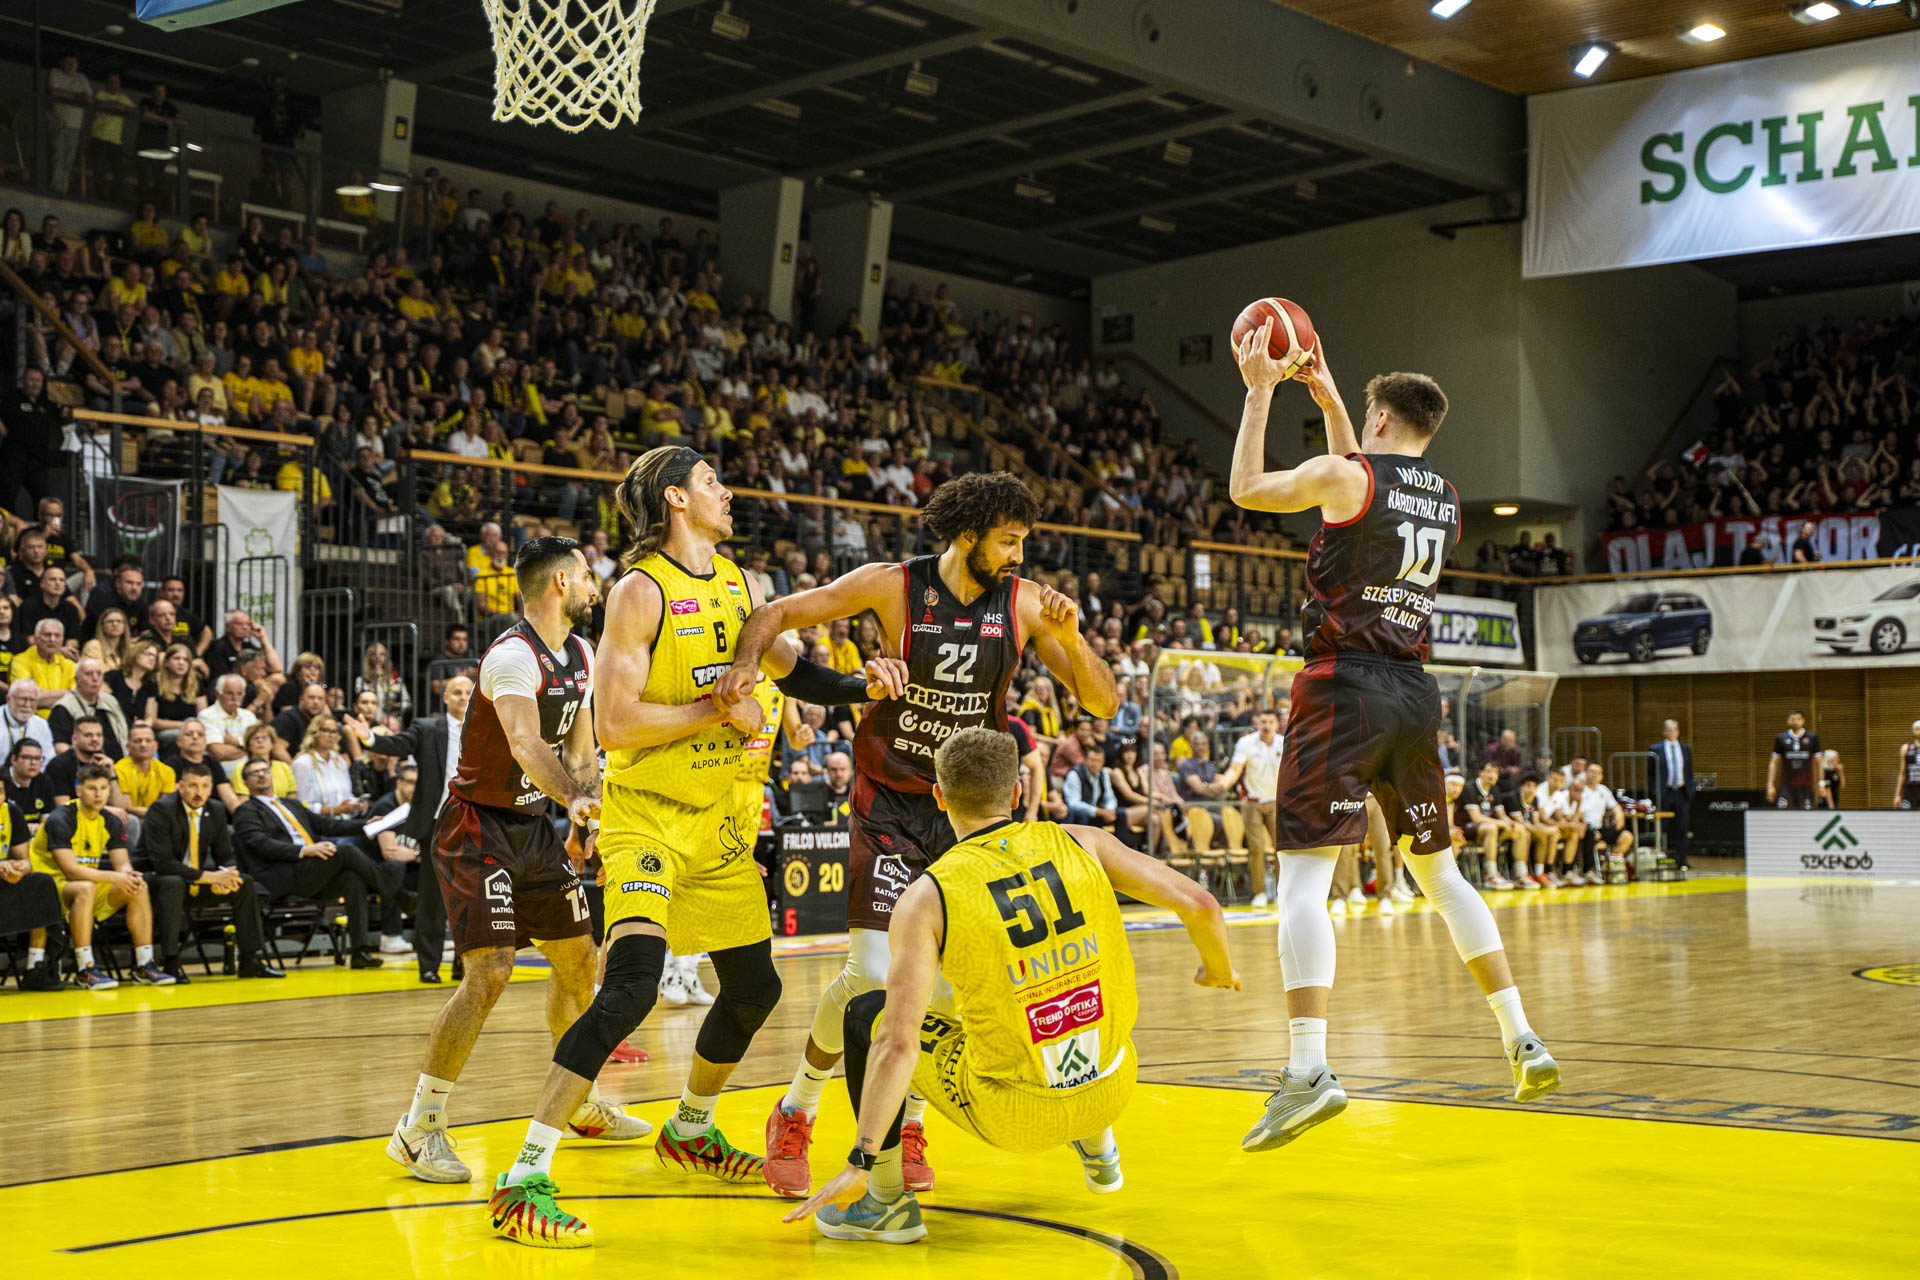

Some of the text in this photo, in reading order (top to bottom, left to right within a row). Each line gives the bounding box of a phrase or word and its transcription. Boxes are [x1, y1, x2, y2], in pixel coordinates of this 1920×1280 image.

[1388, 488, 1437, 520] KÁROLYHÁZ
[1396, 520, 1446, 588] 10
[713, 621, 727, 653] 6
[934, 642, 978, 684] 22
[556, 700, 580, 736] 13
[691, 758, 721, 770] ALPOK
[783, 832, 815, 849] FALCO
[818, 862, 844, 893] 20
[564, 884, 590, 923] 13
[984, 860, 1086, 948] 51
[1006, 932, 1099, 986] UNION
[1016, 990, 1044, 1004] VIENNA
[1045, 974, 1081, 995] INSURANCE
[1032, 997, 1098, 1028] TREND OPTIKA
